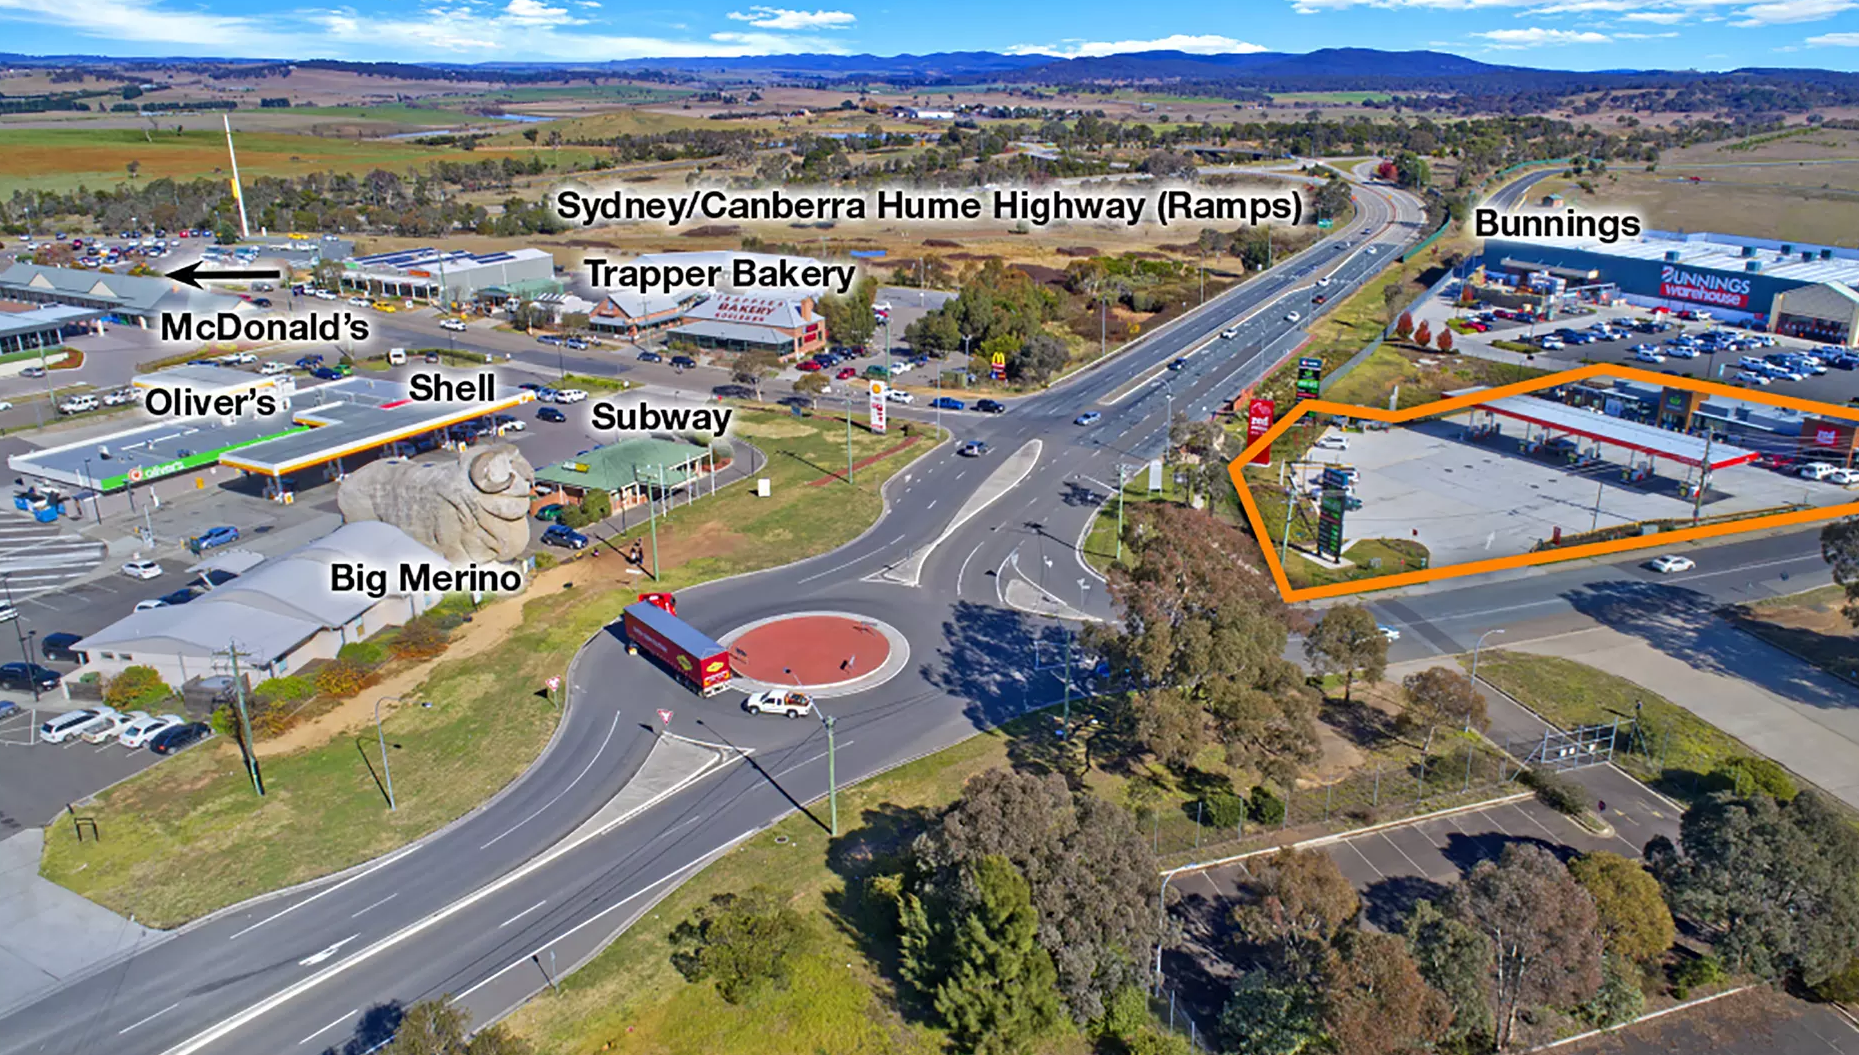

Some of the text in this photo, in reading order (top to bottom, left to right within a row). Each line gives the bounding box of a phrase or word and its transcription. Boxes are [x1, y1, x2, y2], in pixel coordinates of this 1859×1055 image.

[1661, 265, 1750, 295] BUNNINGS
[1665, 284, 1741, 306] warehouse
[718, 303, 776, 316] BAKERY
